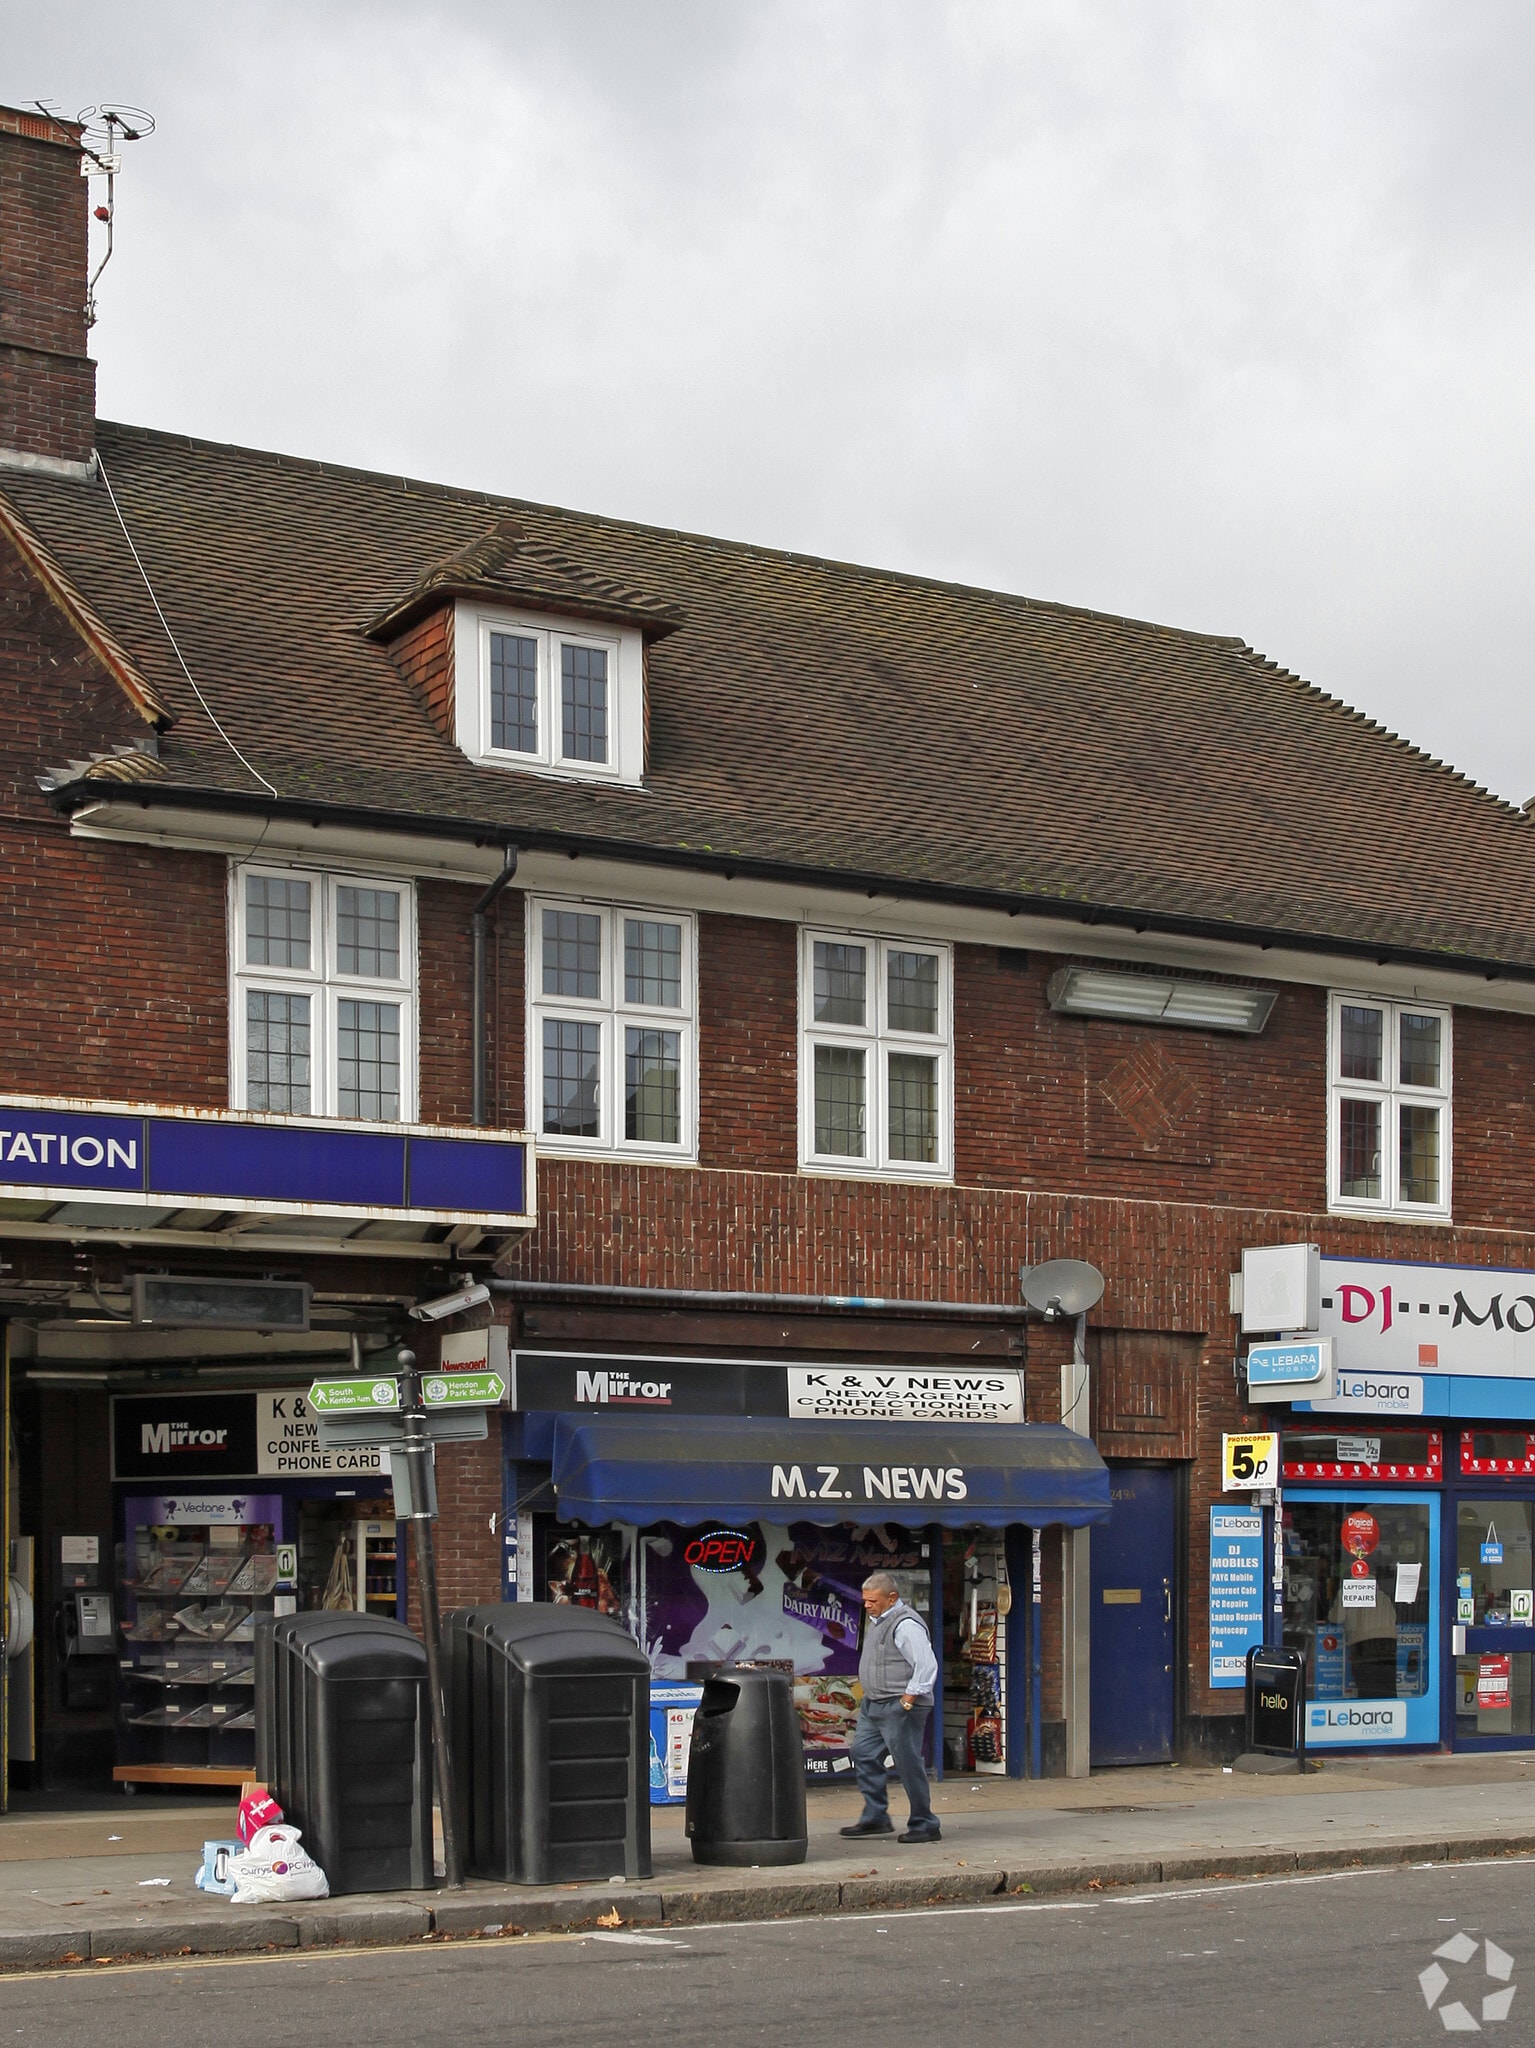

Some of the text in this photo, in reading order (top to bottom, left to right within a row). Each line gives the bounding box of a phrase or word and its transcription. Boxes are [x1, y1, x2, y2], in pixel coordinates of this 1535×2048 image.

[1335, 1284, 1392, 1334] DJ
[1451, 1290, 1535, 1333] MO
[442, 1358, 487, 1372] Newsagent
[1272, 1354, 1317, 1367] LEBARA
[1278, 1365, 1316, 1373] MOBILE
[609, 1372, 630, 1380] THE
[449, 1380, 479, 1389] Hendon
[576, 1371, 671, 1403] Mirror
[807, 1374, 1005, 1392] K & V NEWS
[328, 1388, 353, 1396] South
[449, 1389, 468, 1397] Park
[1343, 1379, 1410, 1399] Lebara
[329, 1396, 356, 1404] Kenton
[825, 1389, 988, 1401] NEWSAGENT
[273, 1397, 307, 1419] K &
[796, 1397, 1014, 1411] CONFECTIONERY
[1377, 1400, 1410, 1410] mobile
[814, 1407, 998, 1420] PHONE CARDS
[142, 1423, 228, 1454] Mirror
[278, 1456, 332, 1470] PHONE
[1232, 1445, 1268, 1480] 5p
[771, 1465, 967, 1500] M.Z. NEWS
[182, 1502, 225, 1513] Vectone
[1223, 1518, 1260, 1528] Lebara
[684, 1540, 755, 1564] OPEN
[1228, 1544, 1241, 1555] DJ
[1211, 1558, 1259, 1568] MOBILES
[1211, 1573, 1254, 1582] PAYG Mobile
[1211, 1586, 1240, 1595] Internet
[1211, 1600, 1249, 1609] PC Repairs
[784, 1594, 858, 1634] DAIRY MILK
[1211, 1612, 1263, 1622] Laptop Repairs
[1211, 1627, 1248, 1635] Photocopy
[1211, 1640, 1224, 1648] Fax
[1260, 1692, 1288, 1710] hello
[670, 1714, 684, 1723] 4G
[1328, 1709, 1393, 1727] Lebara
[1361, 1726, 1393, 1735] mobile
[807, 1760, 829, 1770] HERE
[240, 1867, 273, 1876] Currys
